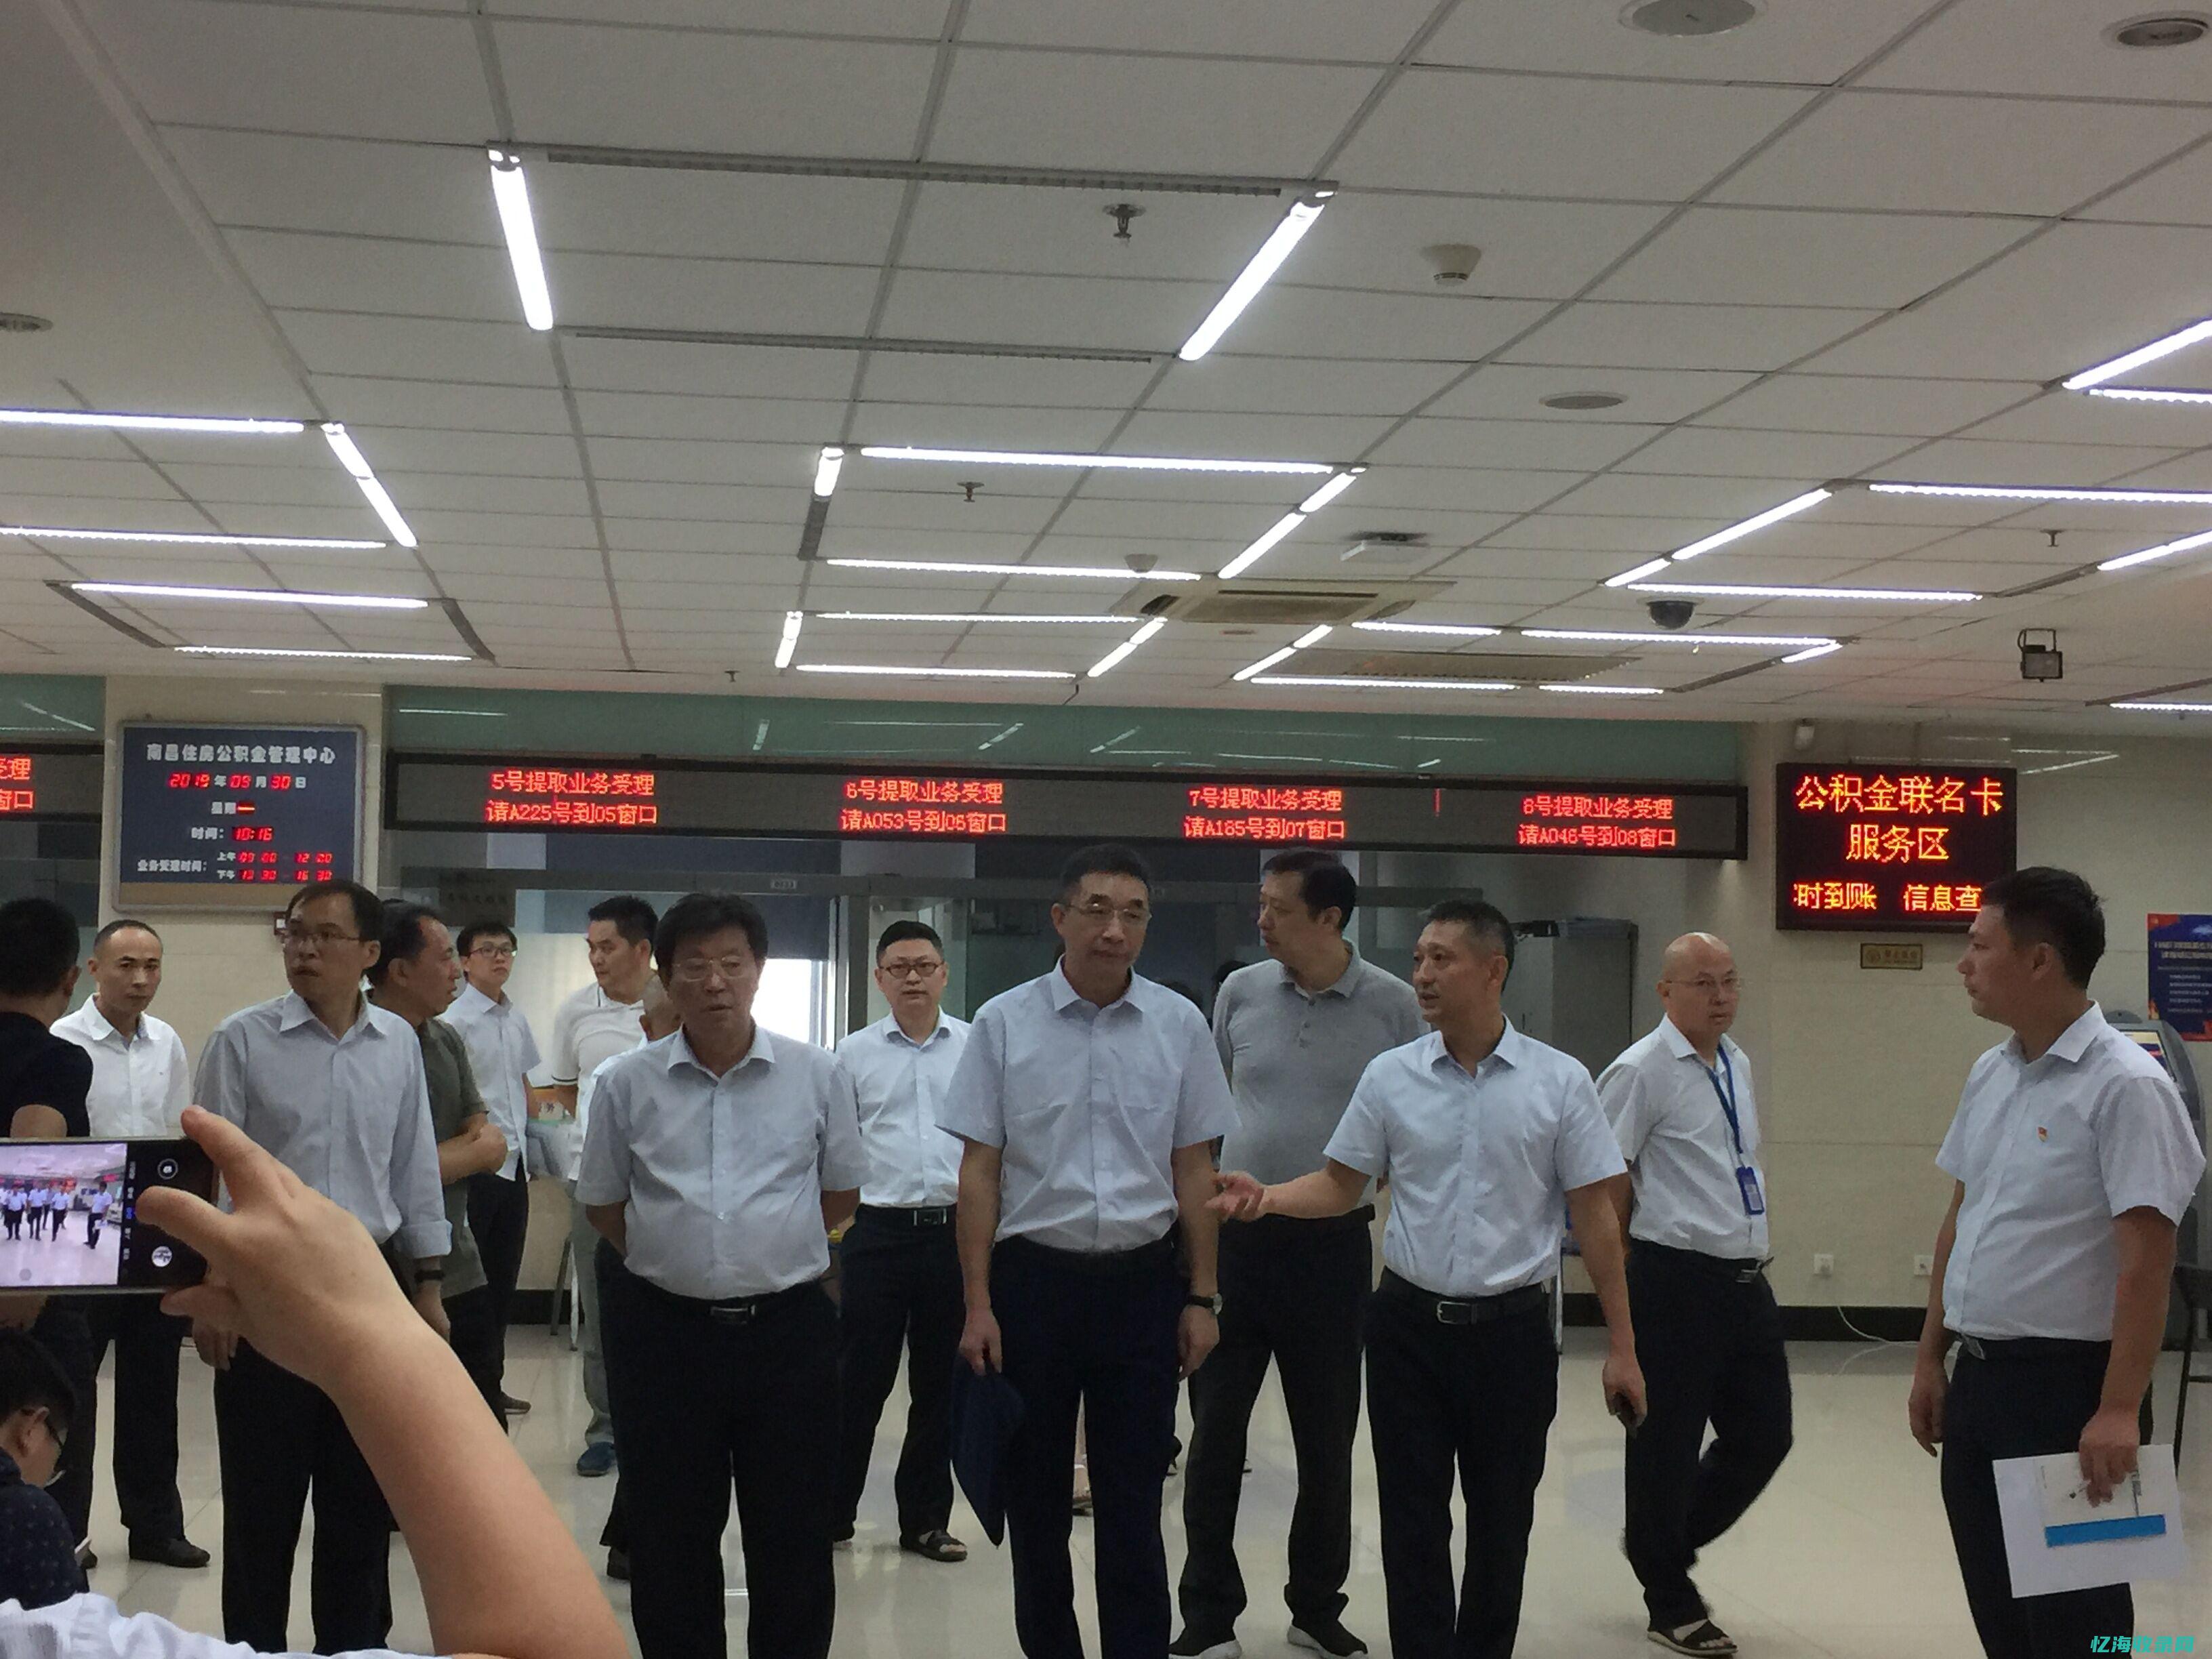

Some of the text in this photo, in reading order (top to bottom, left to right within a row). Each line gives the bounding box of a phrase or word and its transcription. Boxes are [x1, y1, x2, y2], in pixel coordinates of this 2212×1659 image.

[146, 743, 336, 764] 南昌住房公积金管理中心
[491, 770, 655, 796] 5号提取业务受理
[845, 779, 1003, 804] 6号提取业务受理
[1796, 774, 2004, 816] 公积金联名卡
[1189, 787, 1343, 812] 7号提取业务受理
[1522, 795, 1673, 820] 8号提取业务受理
[486, 800, 657, 825] 请A225号到05窗口
[840, 808, 1007, 834] 请A053号到06窗口
[1518, 824, 1676, 848] 请A046号到08窗口
[1845, 823, 1950, 863] 服务区
[1793, 882, 1983, 912] 时到账 信息查
